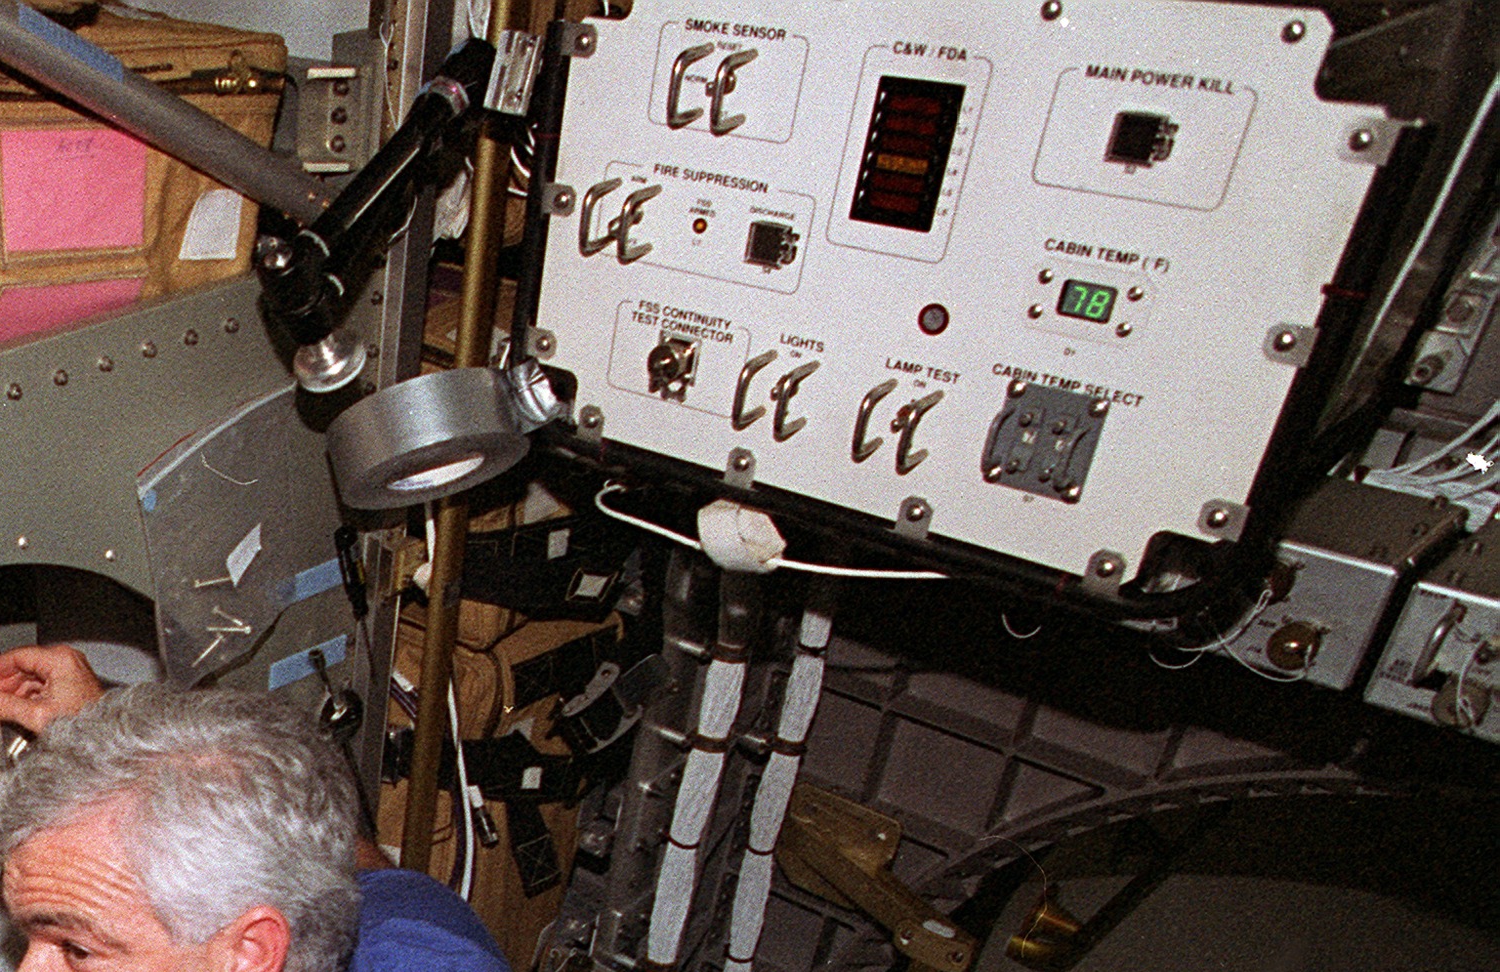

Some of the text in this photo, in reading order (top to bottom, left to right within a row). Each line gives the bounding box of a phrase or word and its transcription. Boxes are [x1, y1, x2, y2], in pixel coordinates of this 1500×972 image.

[685, 18, 787, 40] SMOKE SENSOR
[893, 40, 927, 56] C&W
[937, 46, 968, 62] FDA
[1085, 64, 1236, 96] MAIN POWER KILL
[653, 163, 770, 194] FIRE SUPPRESSION
[1044, 238, 1092, 259] CABIN
[1096, 246, 1140, 268] TEMP
[639, 300, 732, 330] FSS CONTINUITY
[1072, 286, 1111, 319] 78
[631, 311, 734, 344] TEST CONNECTOR
[780, 333, 825, 353] LIGHTS
[885, 357, 961, 385] LAMP TEST
[992, 362, 1145, 408] CABIN TEMP SELECT
